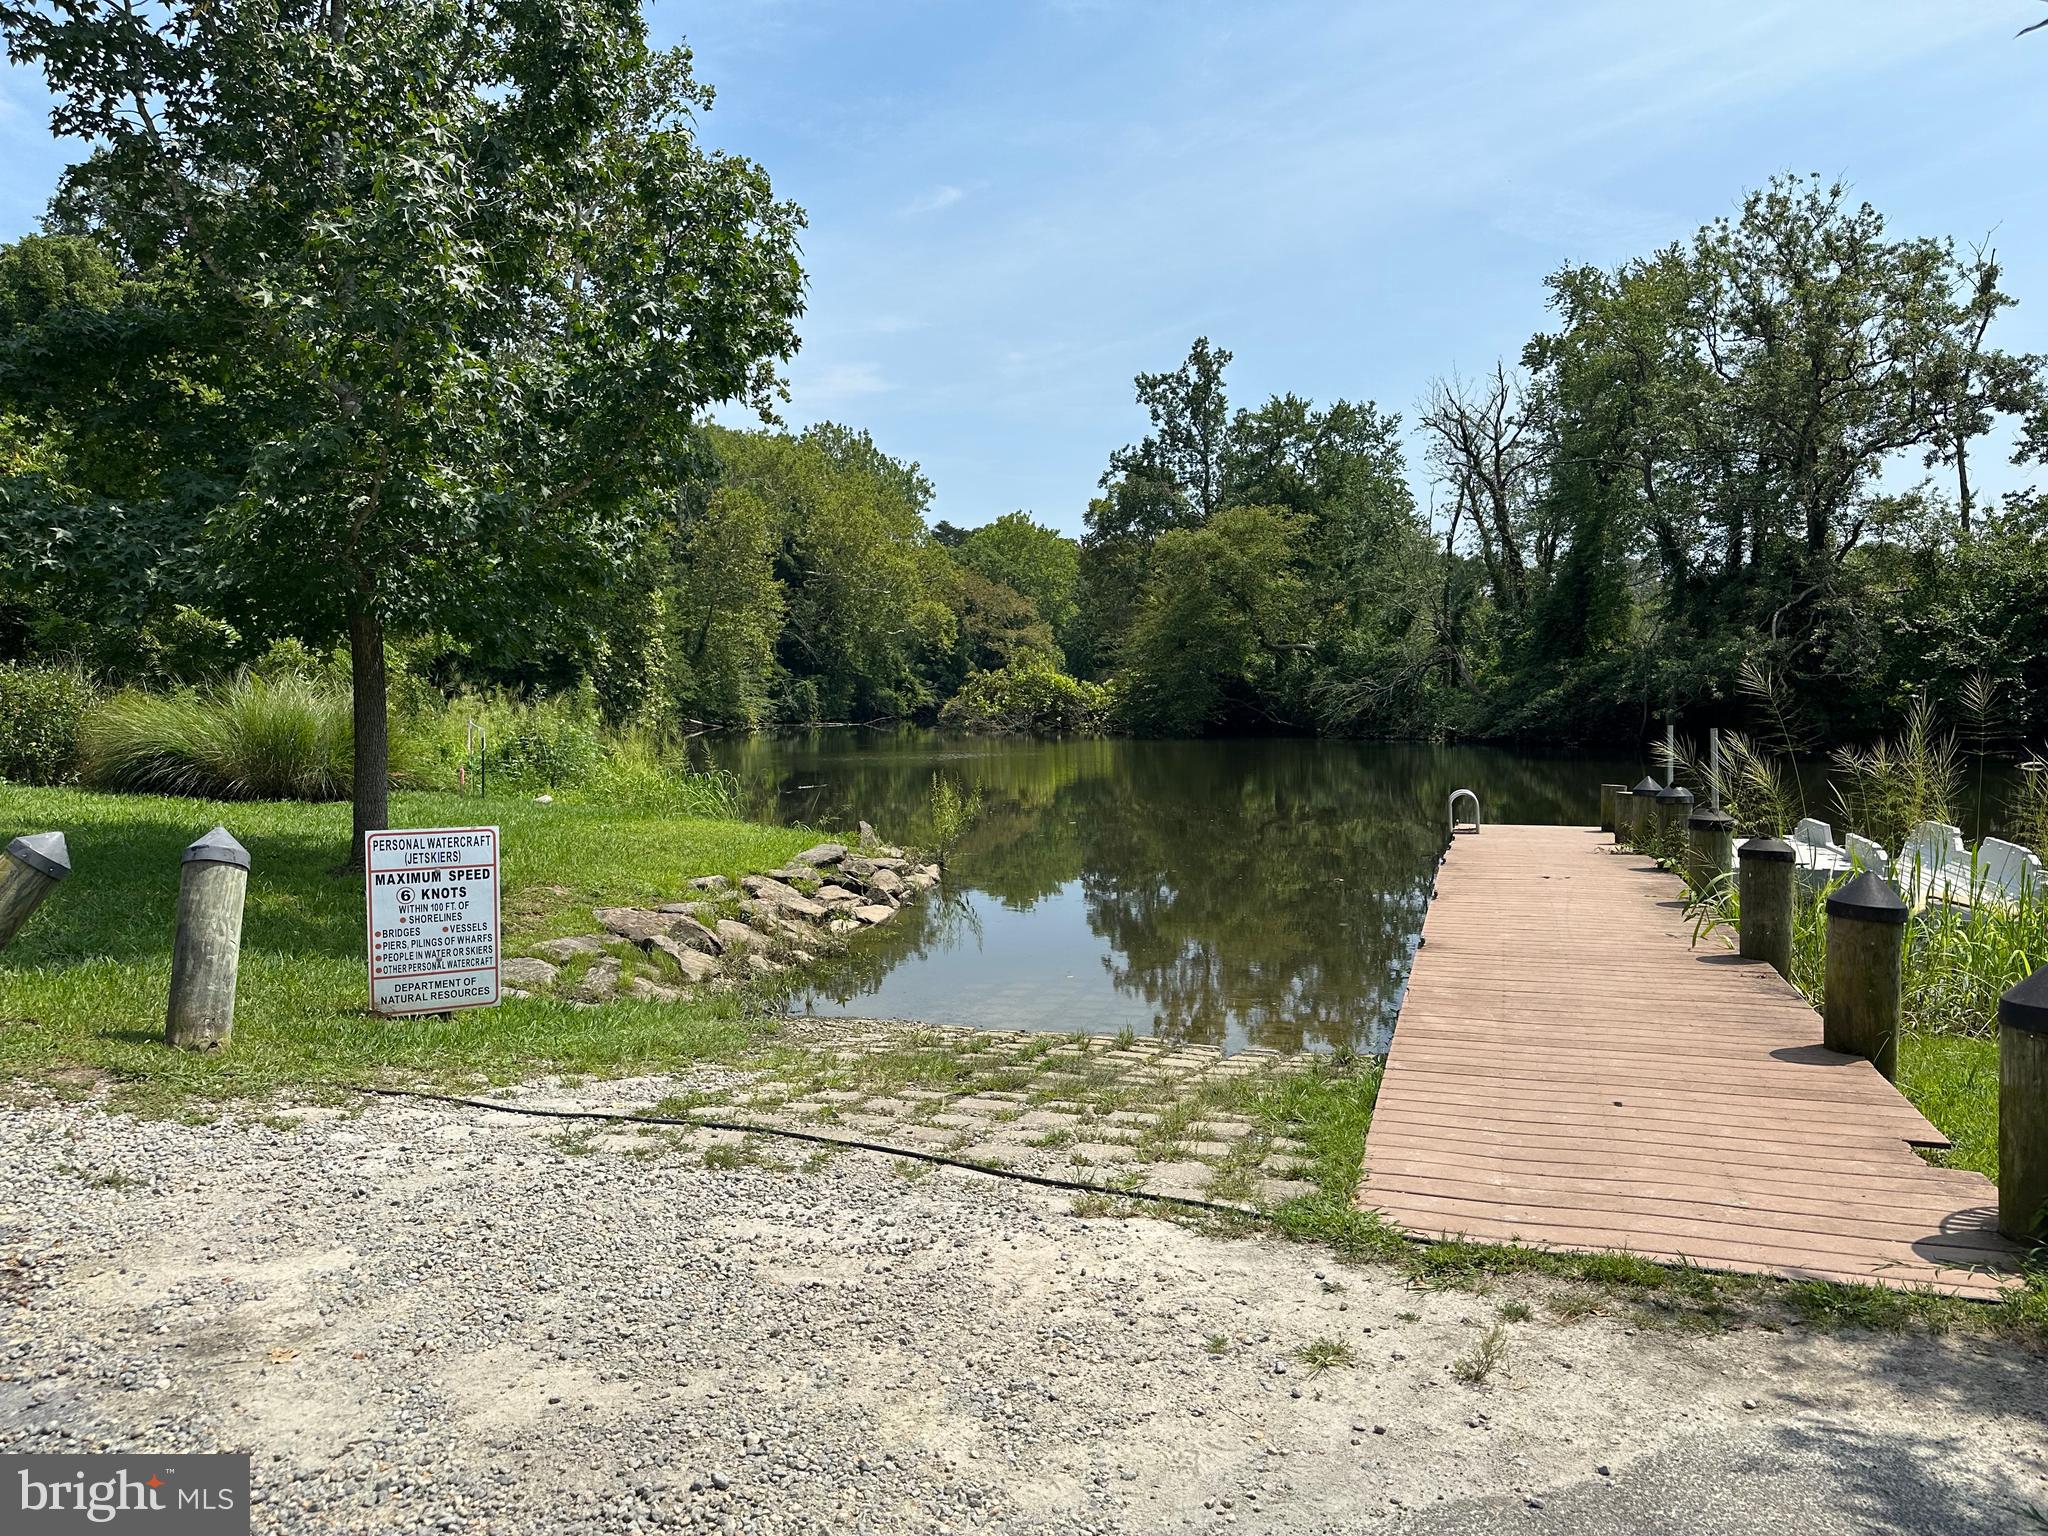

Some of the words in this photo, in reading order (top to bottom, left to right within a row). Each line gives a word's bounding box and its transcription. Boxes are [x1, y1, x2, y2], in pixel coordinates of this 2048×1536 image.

[373, 838, 425, 851] PERSONAL
[428, 835, 491, 849] WATERCRAFT
[405, 851, 461, 866] (JETSKIERS)
[375, 871, 441, 885] MAXIMUM
[449, 869, 490, 881] SPEED
[401, 890, 410, 901] 6
[421, 887, 467, 900] KNOTS
[399, 904, 428, 914] WITHIN
[431, 903, 443, 911] 100
[445, 902, 457, 910] FT.
[458, 901, 469, 910] OF
[409, 913, 462, 924] SHORELINES
[383, 927, 420, 938] BRIDGES
[450, 923, 487, 933] VESSELS
[383, 940, 409, 950] PIERS,
[411, 938, 442, 948] PILINGS
[445, 937, 455, 946] OF
[458, 934, 492, 945] WHARFS
[383, 952, 413, 962] PEOPLE
[416, 951, 423, 959] IN
[425, 949, 451, 959] WATER
[451, 947, 464, 956] OR
[466, 945, 493, 955] SKIERS
[383, 964, 407, 974] OTHER
[408, 961, 446, 972] PERSONAL
[447, 957, 493, 970] WATERCRAFT
[395, 979, 461, 992] DEPARTMENT
[464, 977, 477, 987] OF
[381, 993, 428, 1004] NATURAL
[431, 987, 490, 1000] RESOURCES
